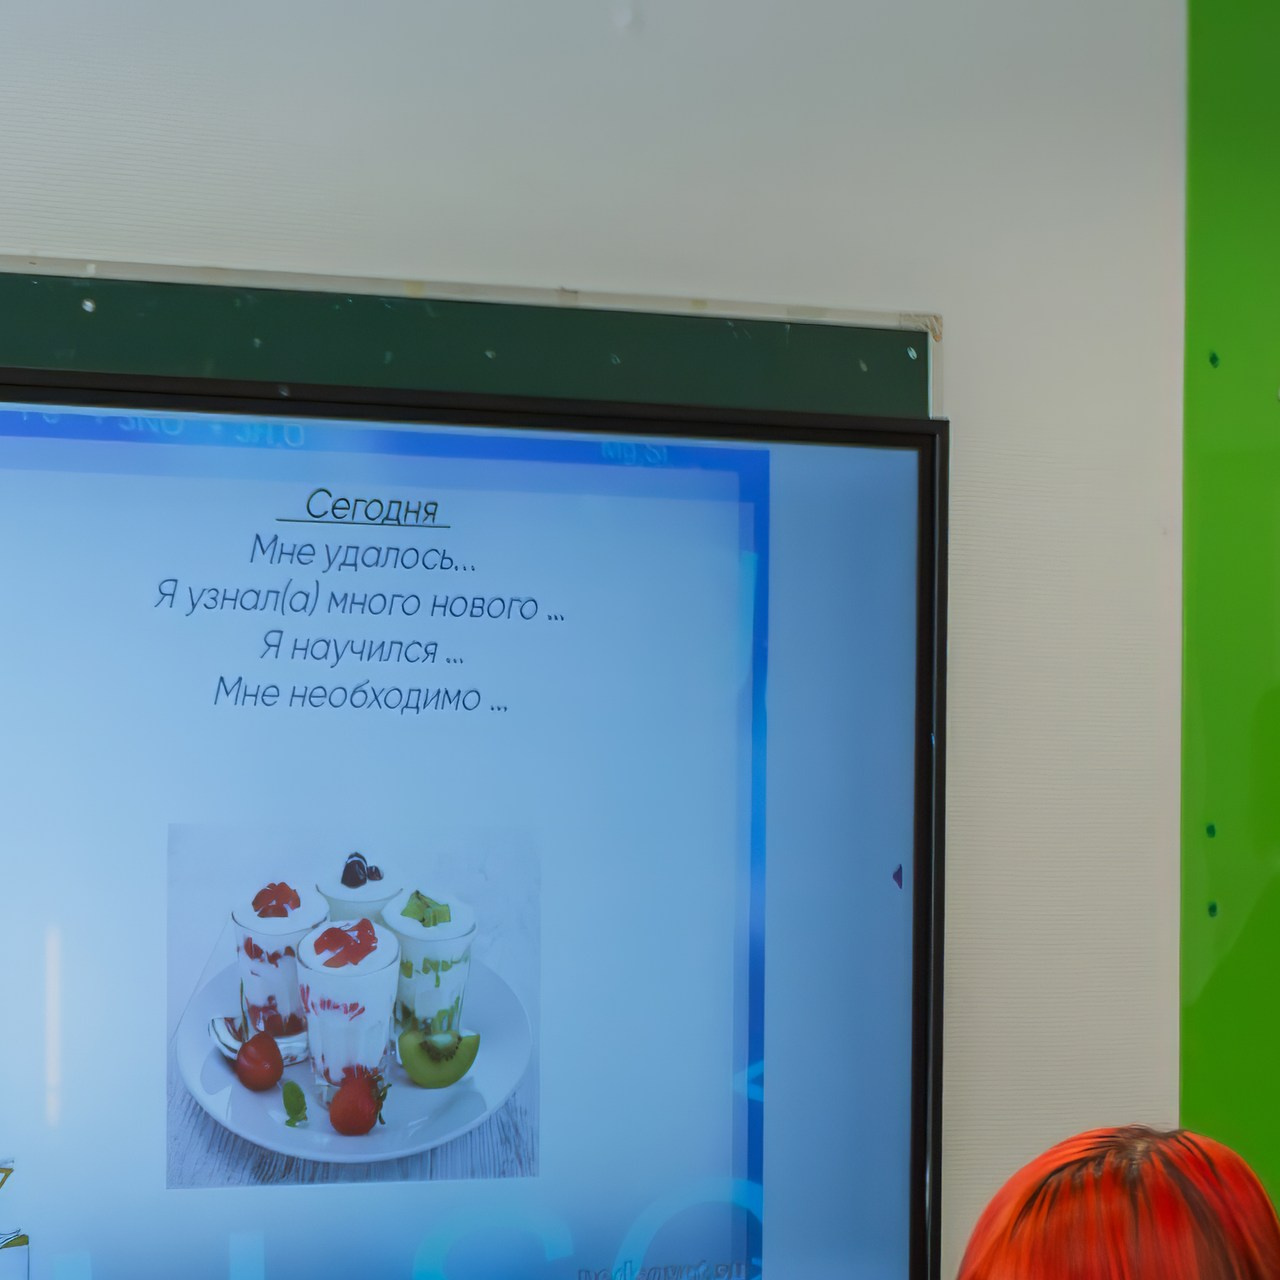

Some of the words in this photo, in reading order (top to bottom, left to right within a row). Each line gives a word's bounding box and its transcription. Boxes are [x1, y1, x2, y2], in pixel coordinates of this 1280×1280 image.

[306, 488, 438, 525] Сегодня
[250, 533, 316, 565] Мне
[154, 578, 178, 608] Я
[185, 578, 320, 616] узнал(а)
[327, 591, 421, 616] много
[431, 595, 538, 620] нового
[260, 629, 284, 659] Я
[291, 638, 438, 668] научился
[214, 675, 280, 706] Мне
[289, 679, 481, 715] необходимо
